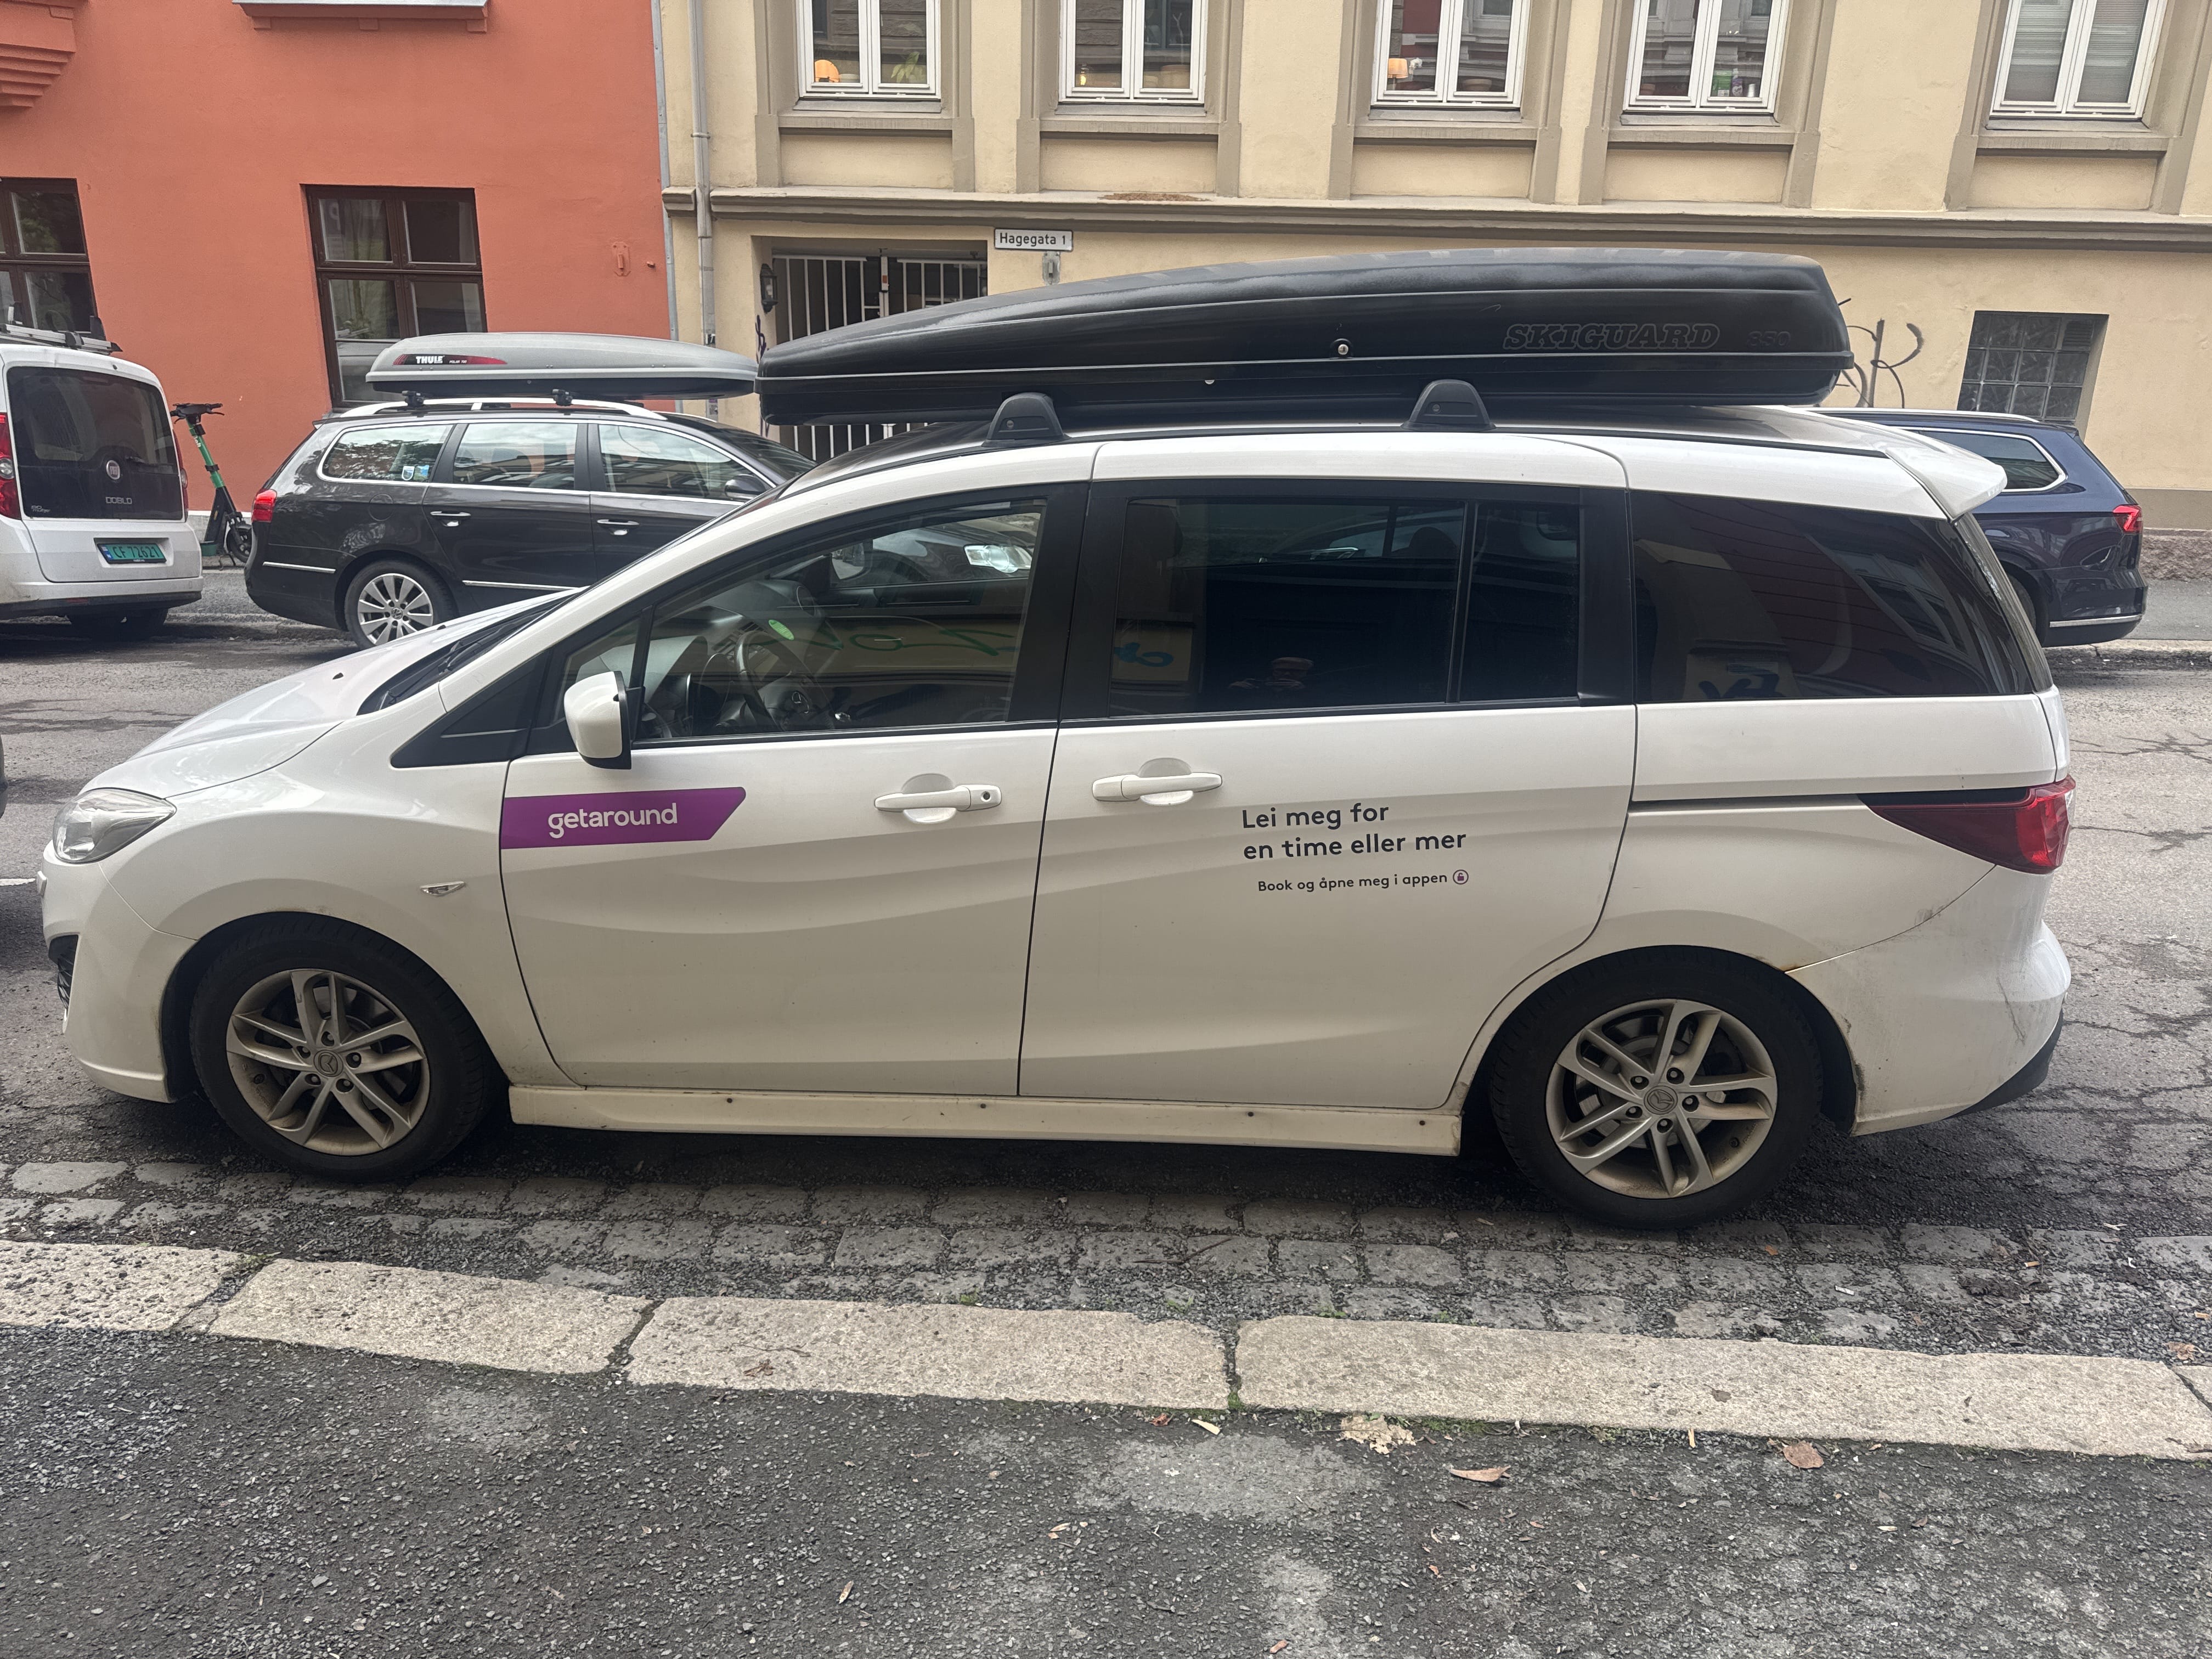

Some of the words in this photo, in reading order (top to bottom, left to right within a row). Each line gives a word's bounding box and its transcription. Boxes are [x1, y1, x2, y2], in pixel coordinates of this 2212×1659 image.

[1000, 232, 1056, 247] Hagegata
[1062, 235, 1065, 245] 1
[1503, 323, 1720, 351] SKIGUARD
[415, 355, 443, 364] THULE
[112, 546, 126, 558] CF
[127, 546, 160, 558] 72621
[548, 802, 678, 839] getaround
[1242, 807, 1277, 829] Lei
[1286, 809, 1341, 830] meg
[1350, 803, 1389, 822] for
[1243, 844, 1273, 860] en
[1281, 837, 1342, 858] time
[1351, 833, 1406, 854] eller
[1415, 833, 1466, 851] mer
[1258, 879, 1293, 891] Book
[1297, 881, 1314, 893] og
[1319, 877, 1355, 891] åpne
[1358, 876, 1390, 889] meg
[1394, 874, 1398, 885] i
[1402, 873, 1447, 887] appen
